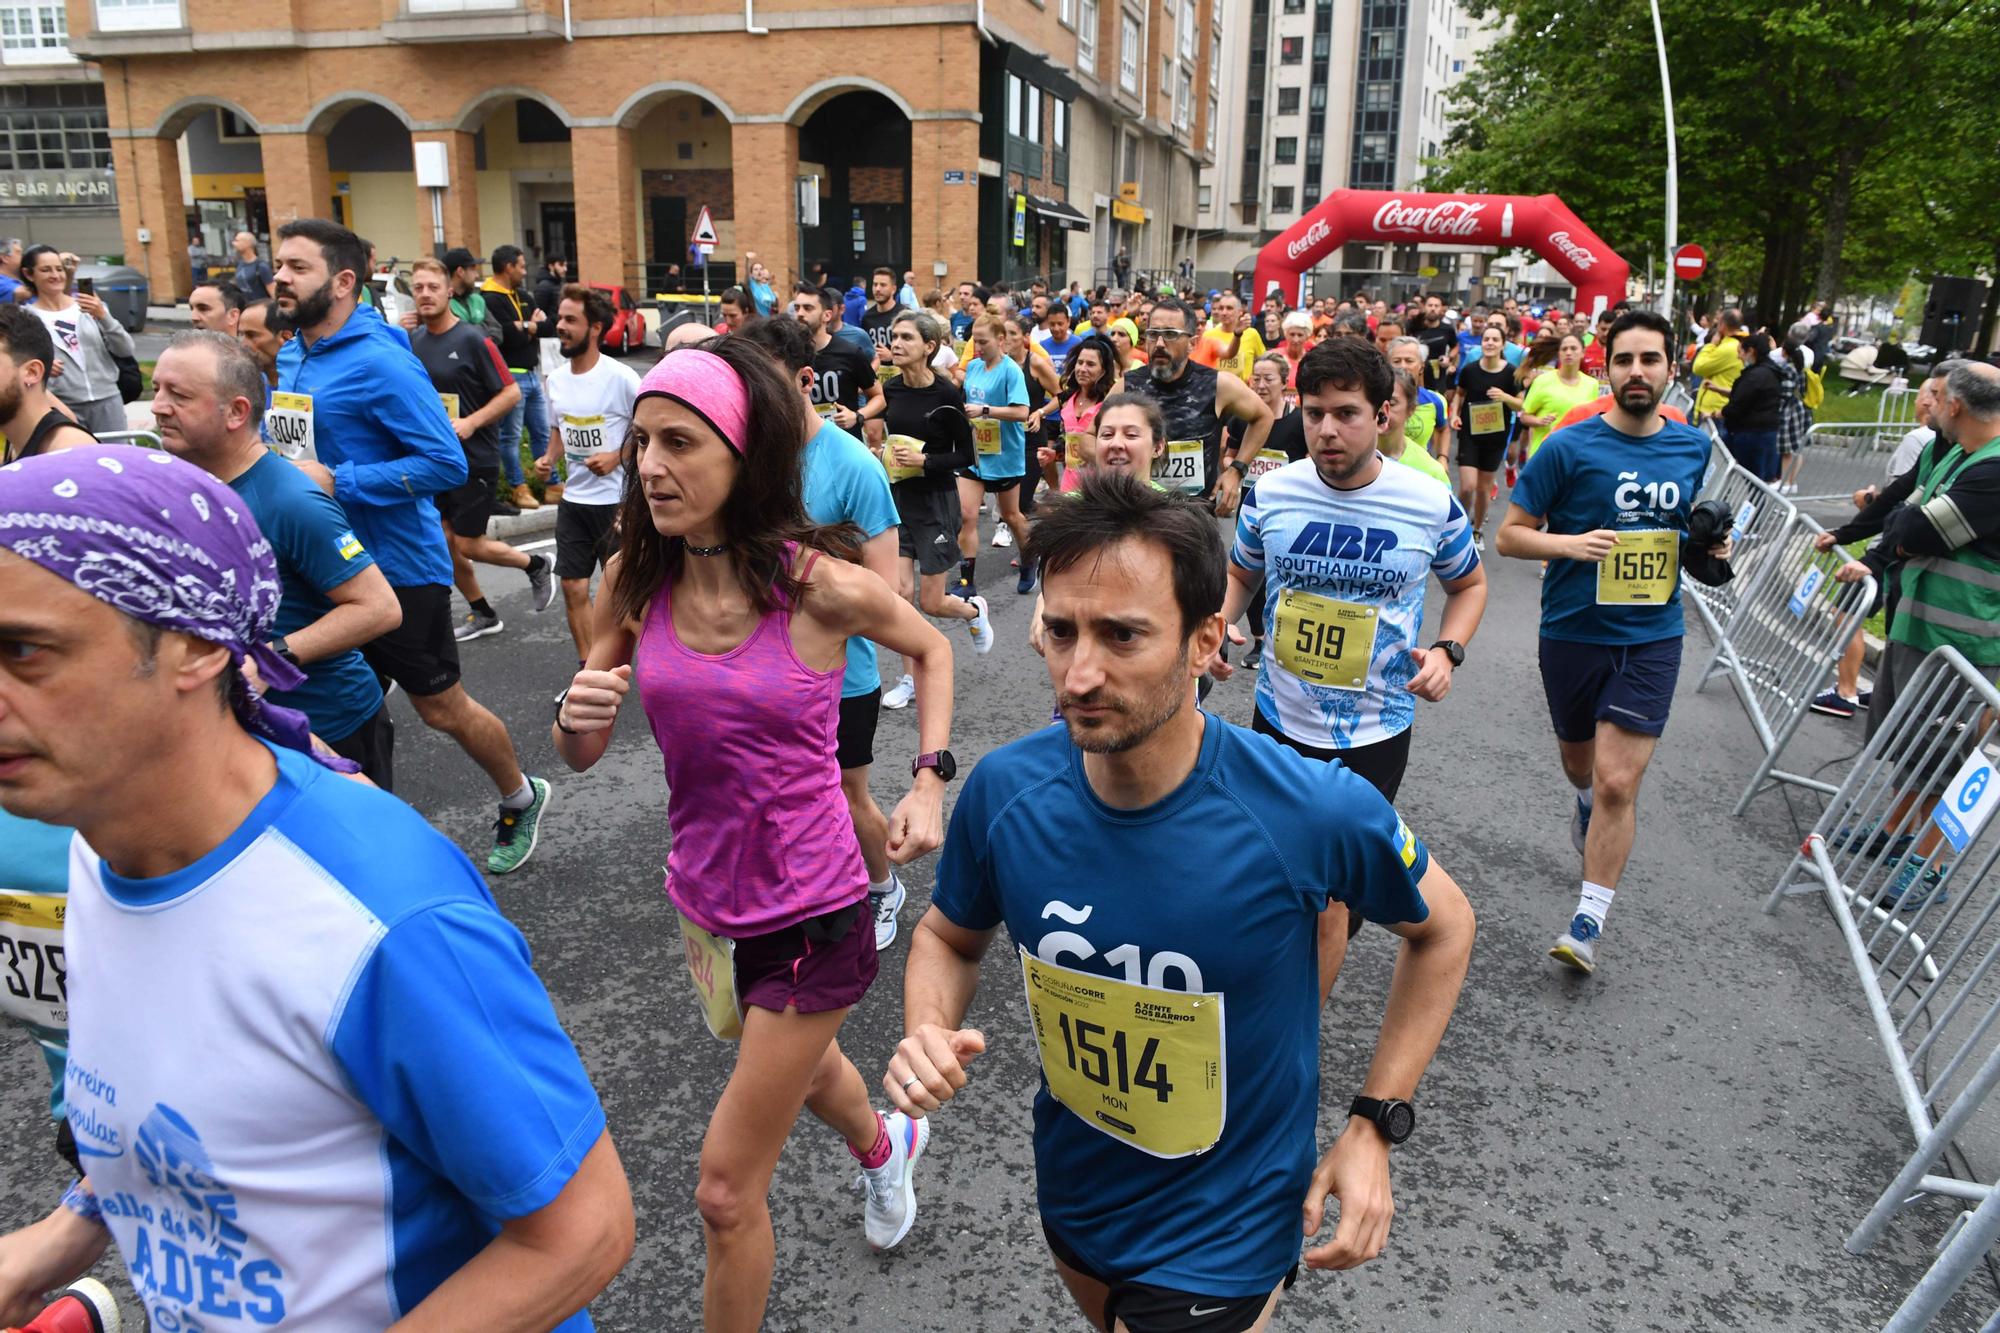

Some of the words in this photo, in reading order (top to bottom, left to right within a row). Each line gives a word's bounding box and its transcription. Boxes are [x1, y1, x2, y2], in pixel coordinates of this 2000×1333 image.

[16, 182, 49, 196] BAR
[56, 181, 110, 196] ANCAR
[1372, 199, 1488, 236] Coca-Cola
[270, 415, 307, 449] 3048
[566, 428, 603, 448] 3308
[1288, 521, 1399, 564] ABP
[1274, 555, 1408, 583] SOUTHAMPTON
[1614, 551, 1668, 580] 1562
[1295, 618, 1346, 660] 519
[1135, 1007, 1153, 1017] DOS
[1154, 1012, 1196, 1022] BARRIOS
[1143, 1003, 1172, 1014] XENTE
[1059, 1011, 1174, 1103] 1514
[1102, 1092, 1128, 1112] MON
